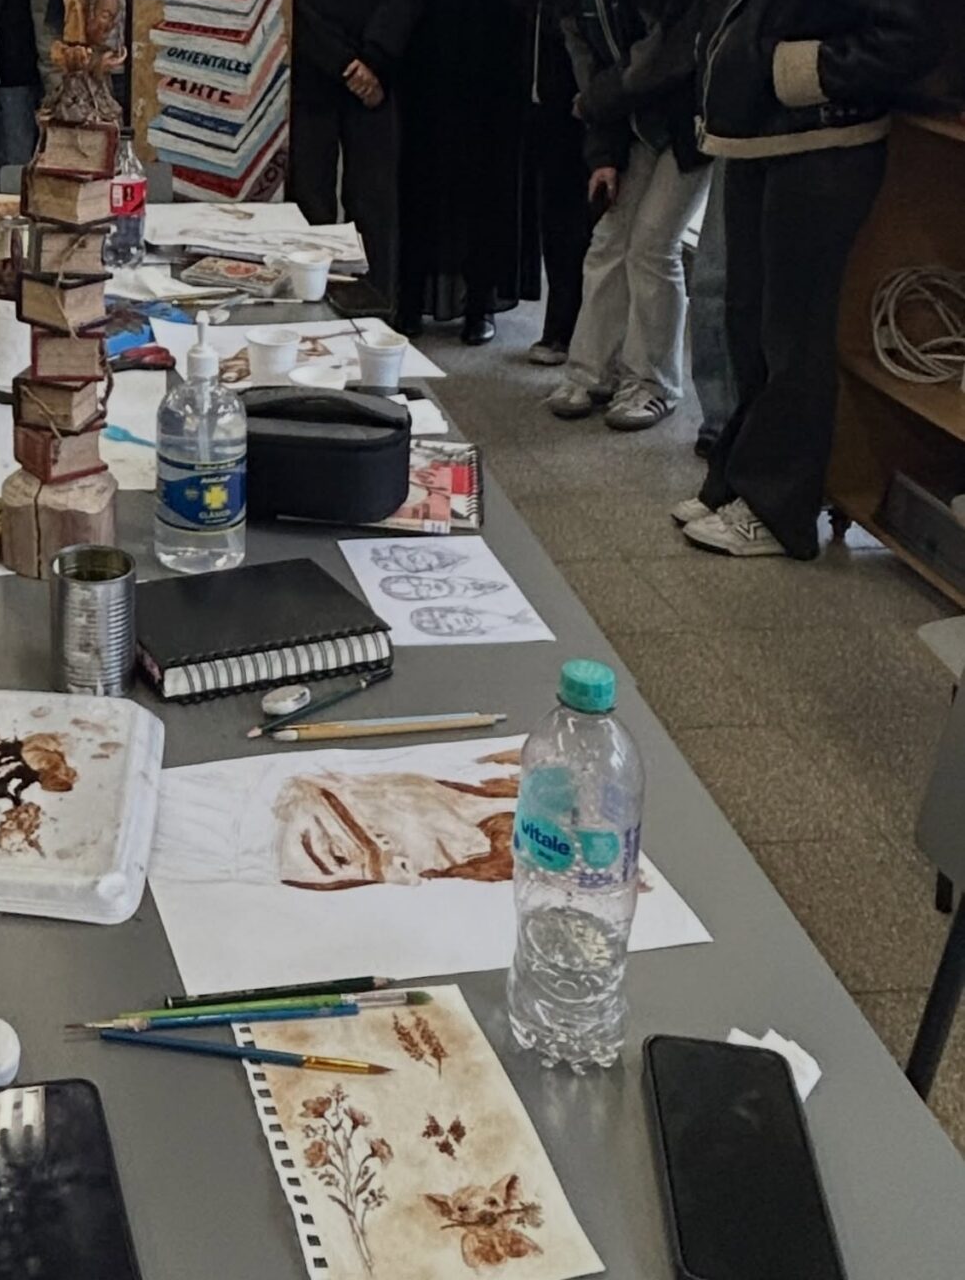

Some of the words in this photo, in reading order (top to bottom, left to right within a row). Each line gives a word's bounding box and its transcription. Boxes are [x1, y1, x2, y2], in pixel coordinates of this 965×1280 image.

[166, 46, 253, 75] ORIENTALES
[165, 75, 233, 105] ARTE
[521, 817, 571, 857] vitale
